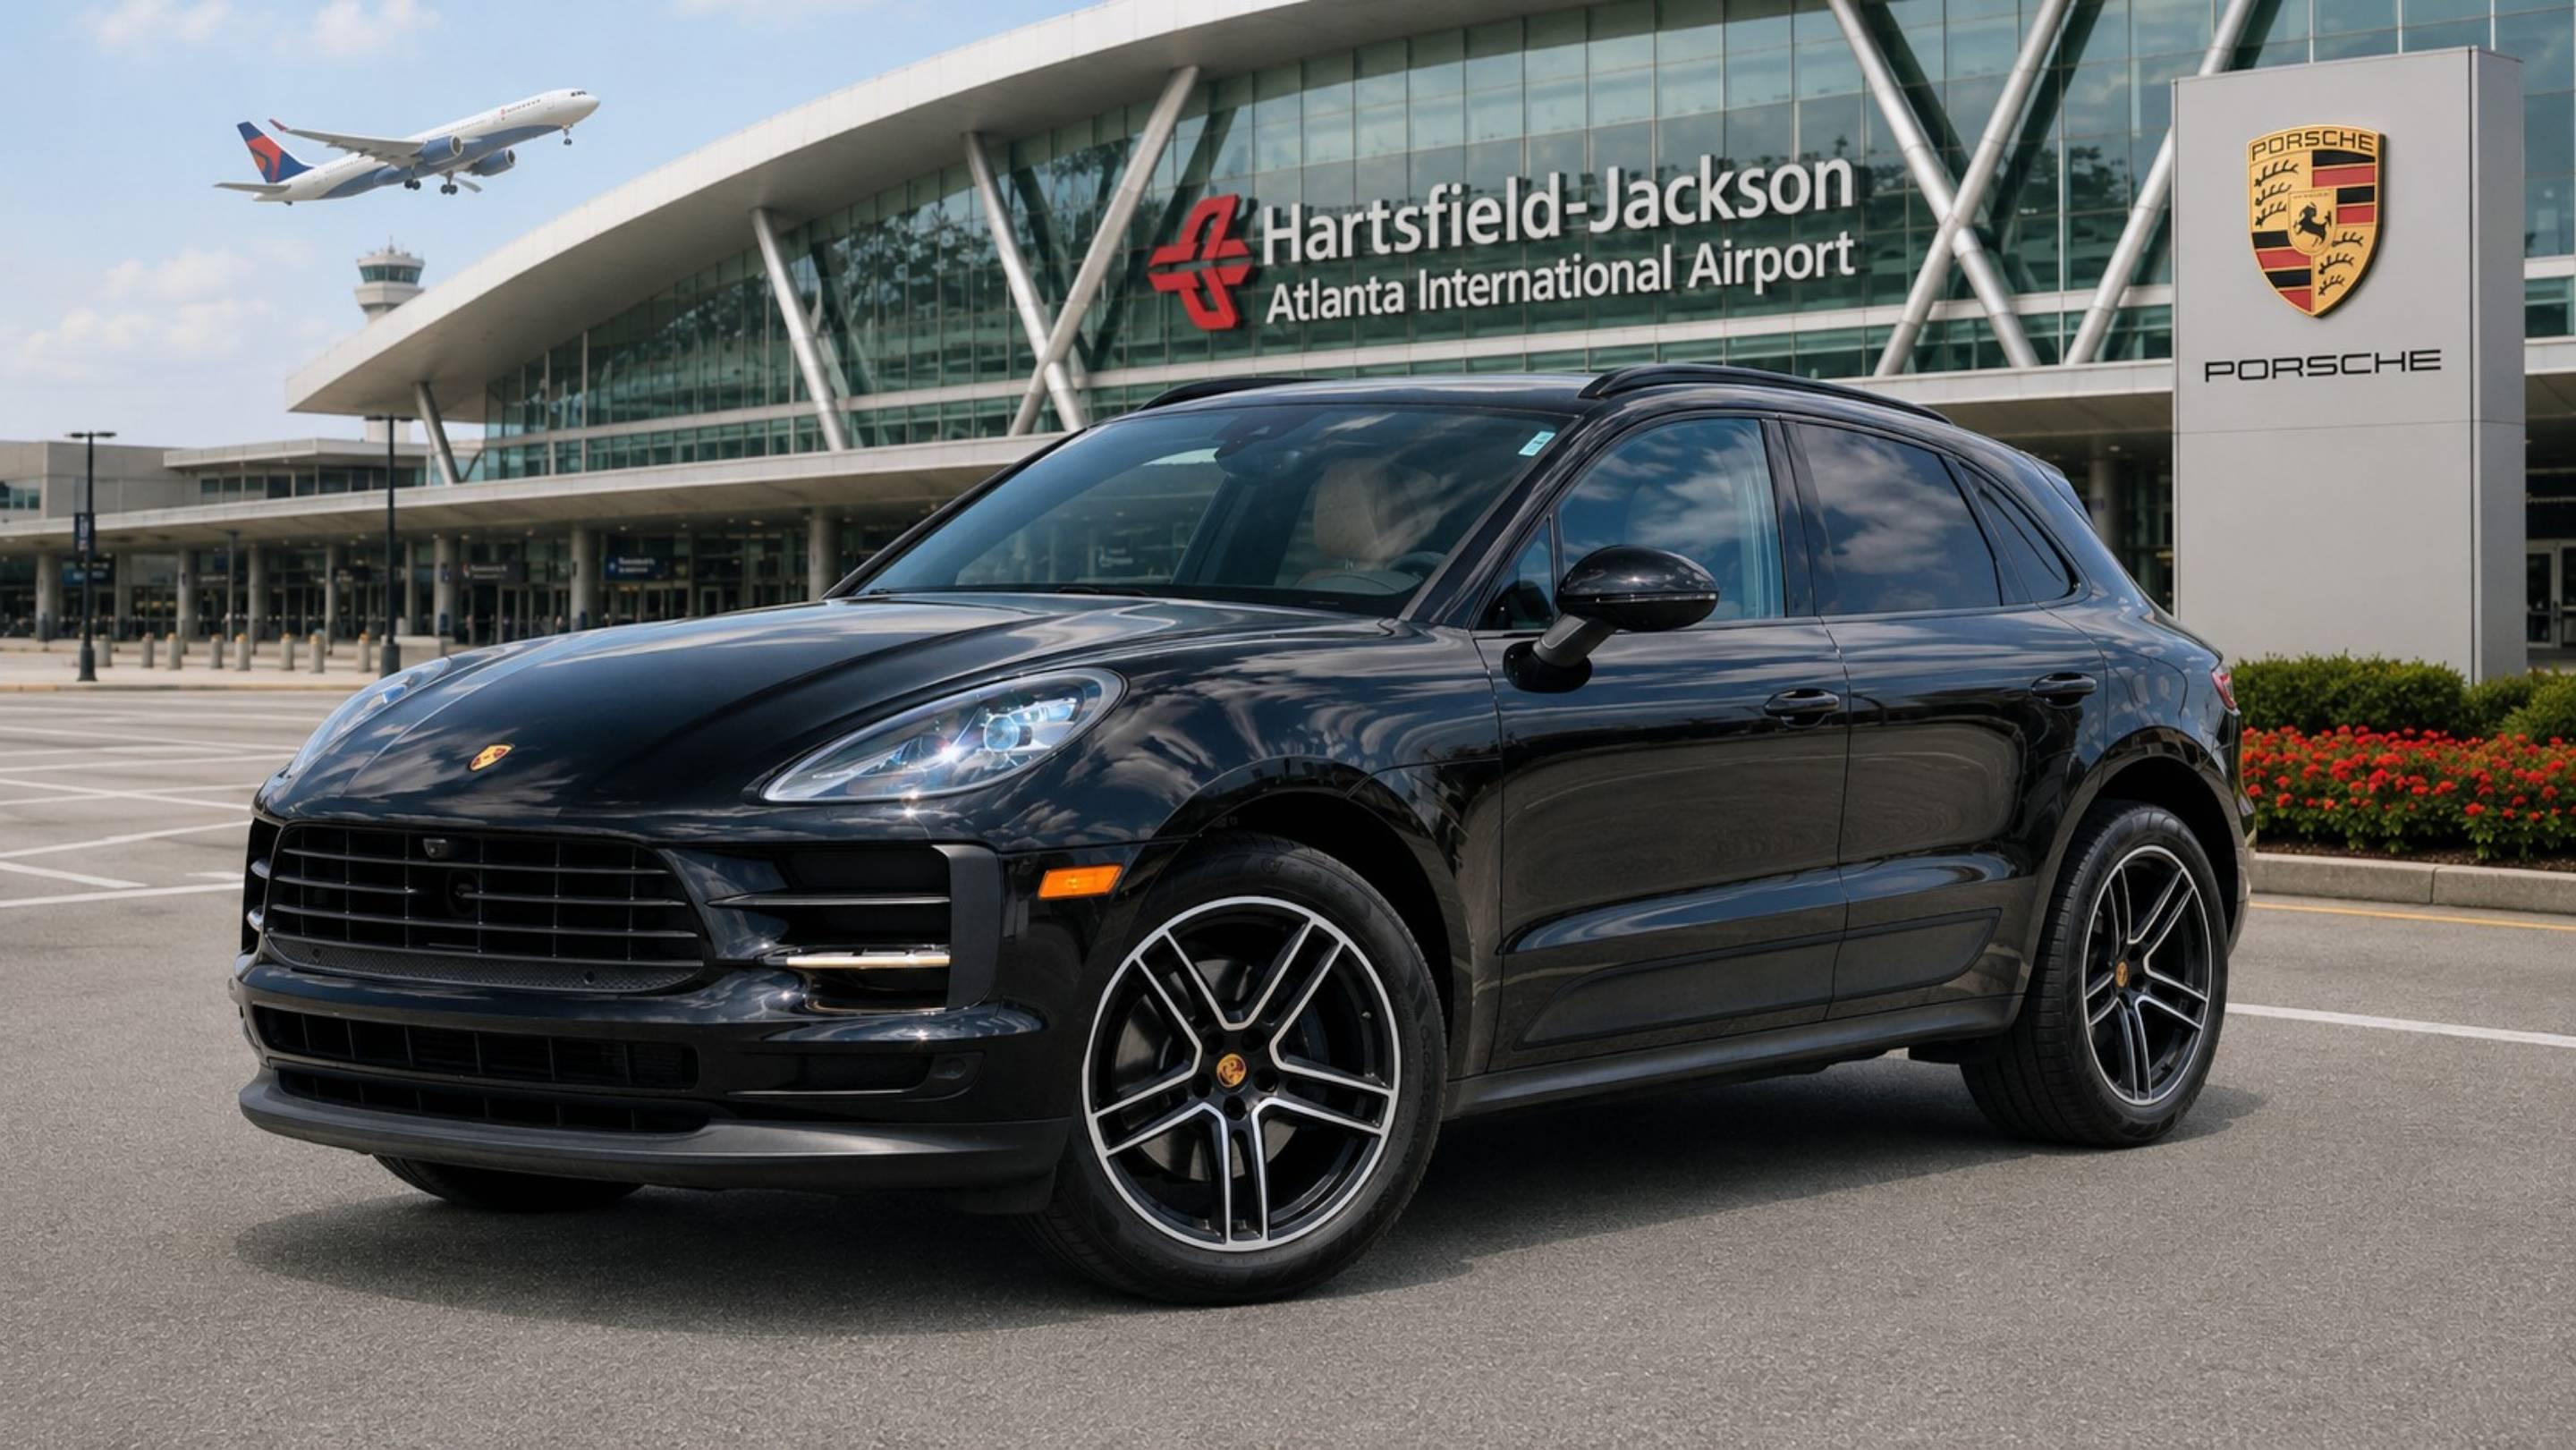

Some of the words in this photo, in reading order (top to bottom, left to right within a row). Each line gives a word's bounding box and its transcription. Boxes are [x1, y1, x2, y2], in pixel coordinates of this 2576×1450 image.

[2252, 130, 2375, 161] PORSCHE
[1263, 154, 1853, 266] Hartsfield-Jackson
[1266, 276, 1404, 323] Atlanta
[1419, 242, 1673, 311] International
[1688, 230, 1856, 295] Airport
[2204, 349, 2442, 383] PORSCHE
